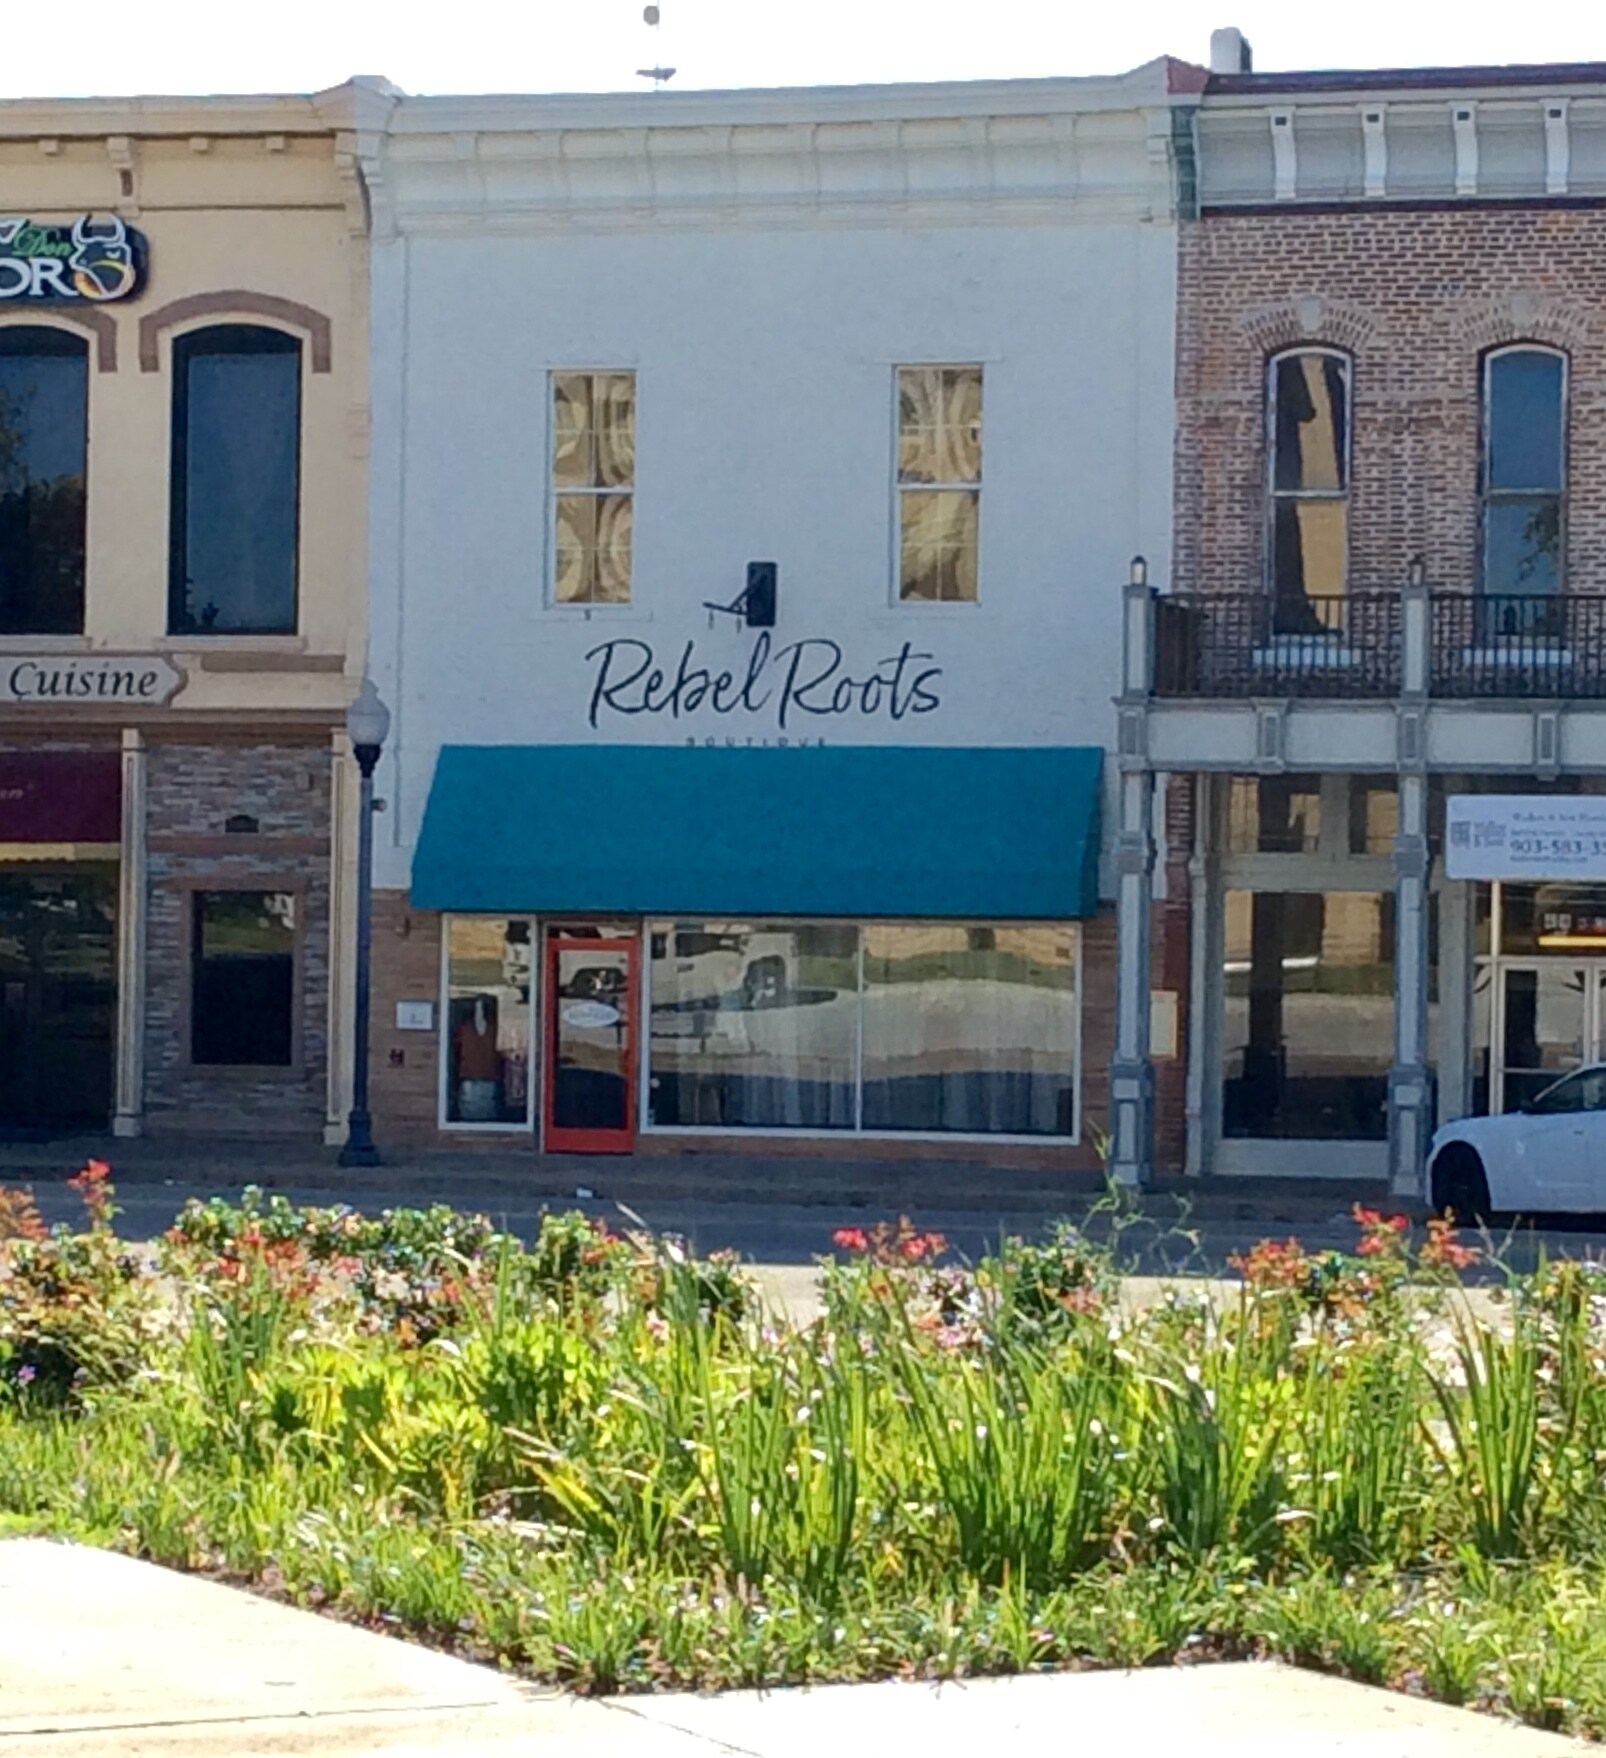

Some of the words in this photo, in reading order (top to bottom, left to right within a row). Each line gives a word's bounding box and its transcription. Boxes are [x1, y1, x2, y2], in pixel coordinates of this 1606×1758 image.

[8, 661, 158, 697] Cuisine
[585, 631, 772, 729] Rebel
[774, 638, 943, 729] Roots
